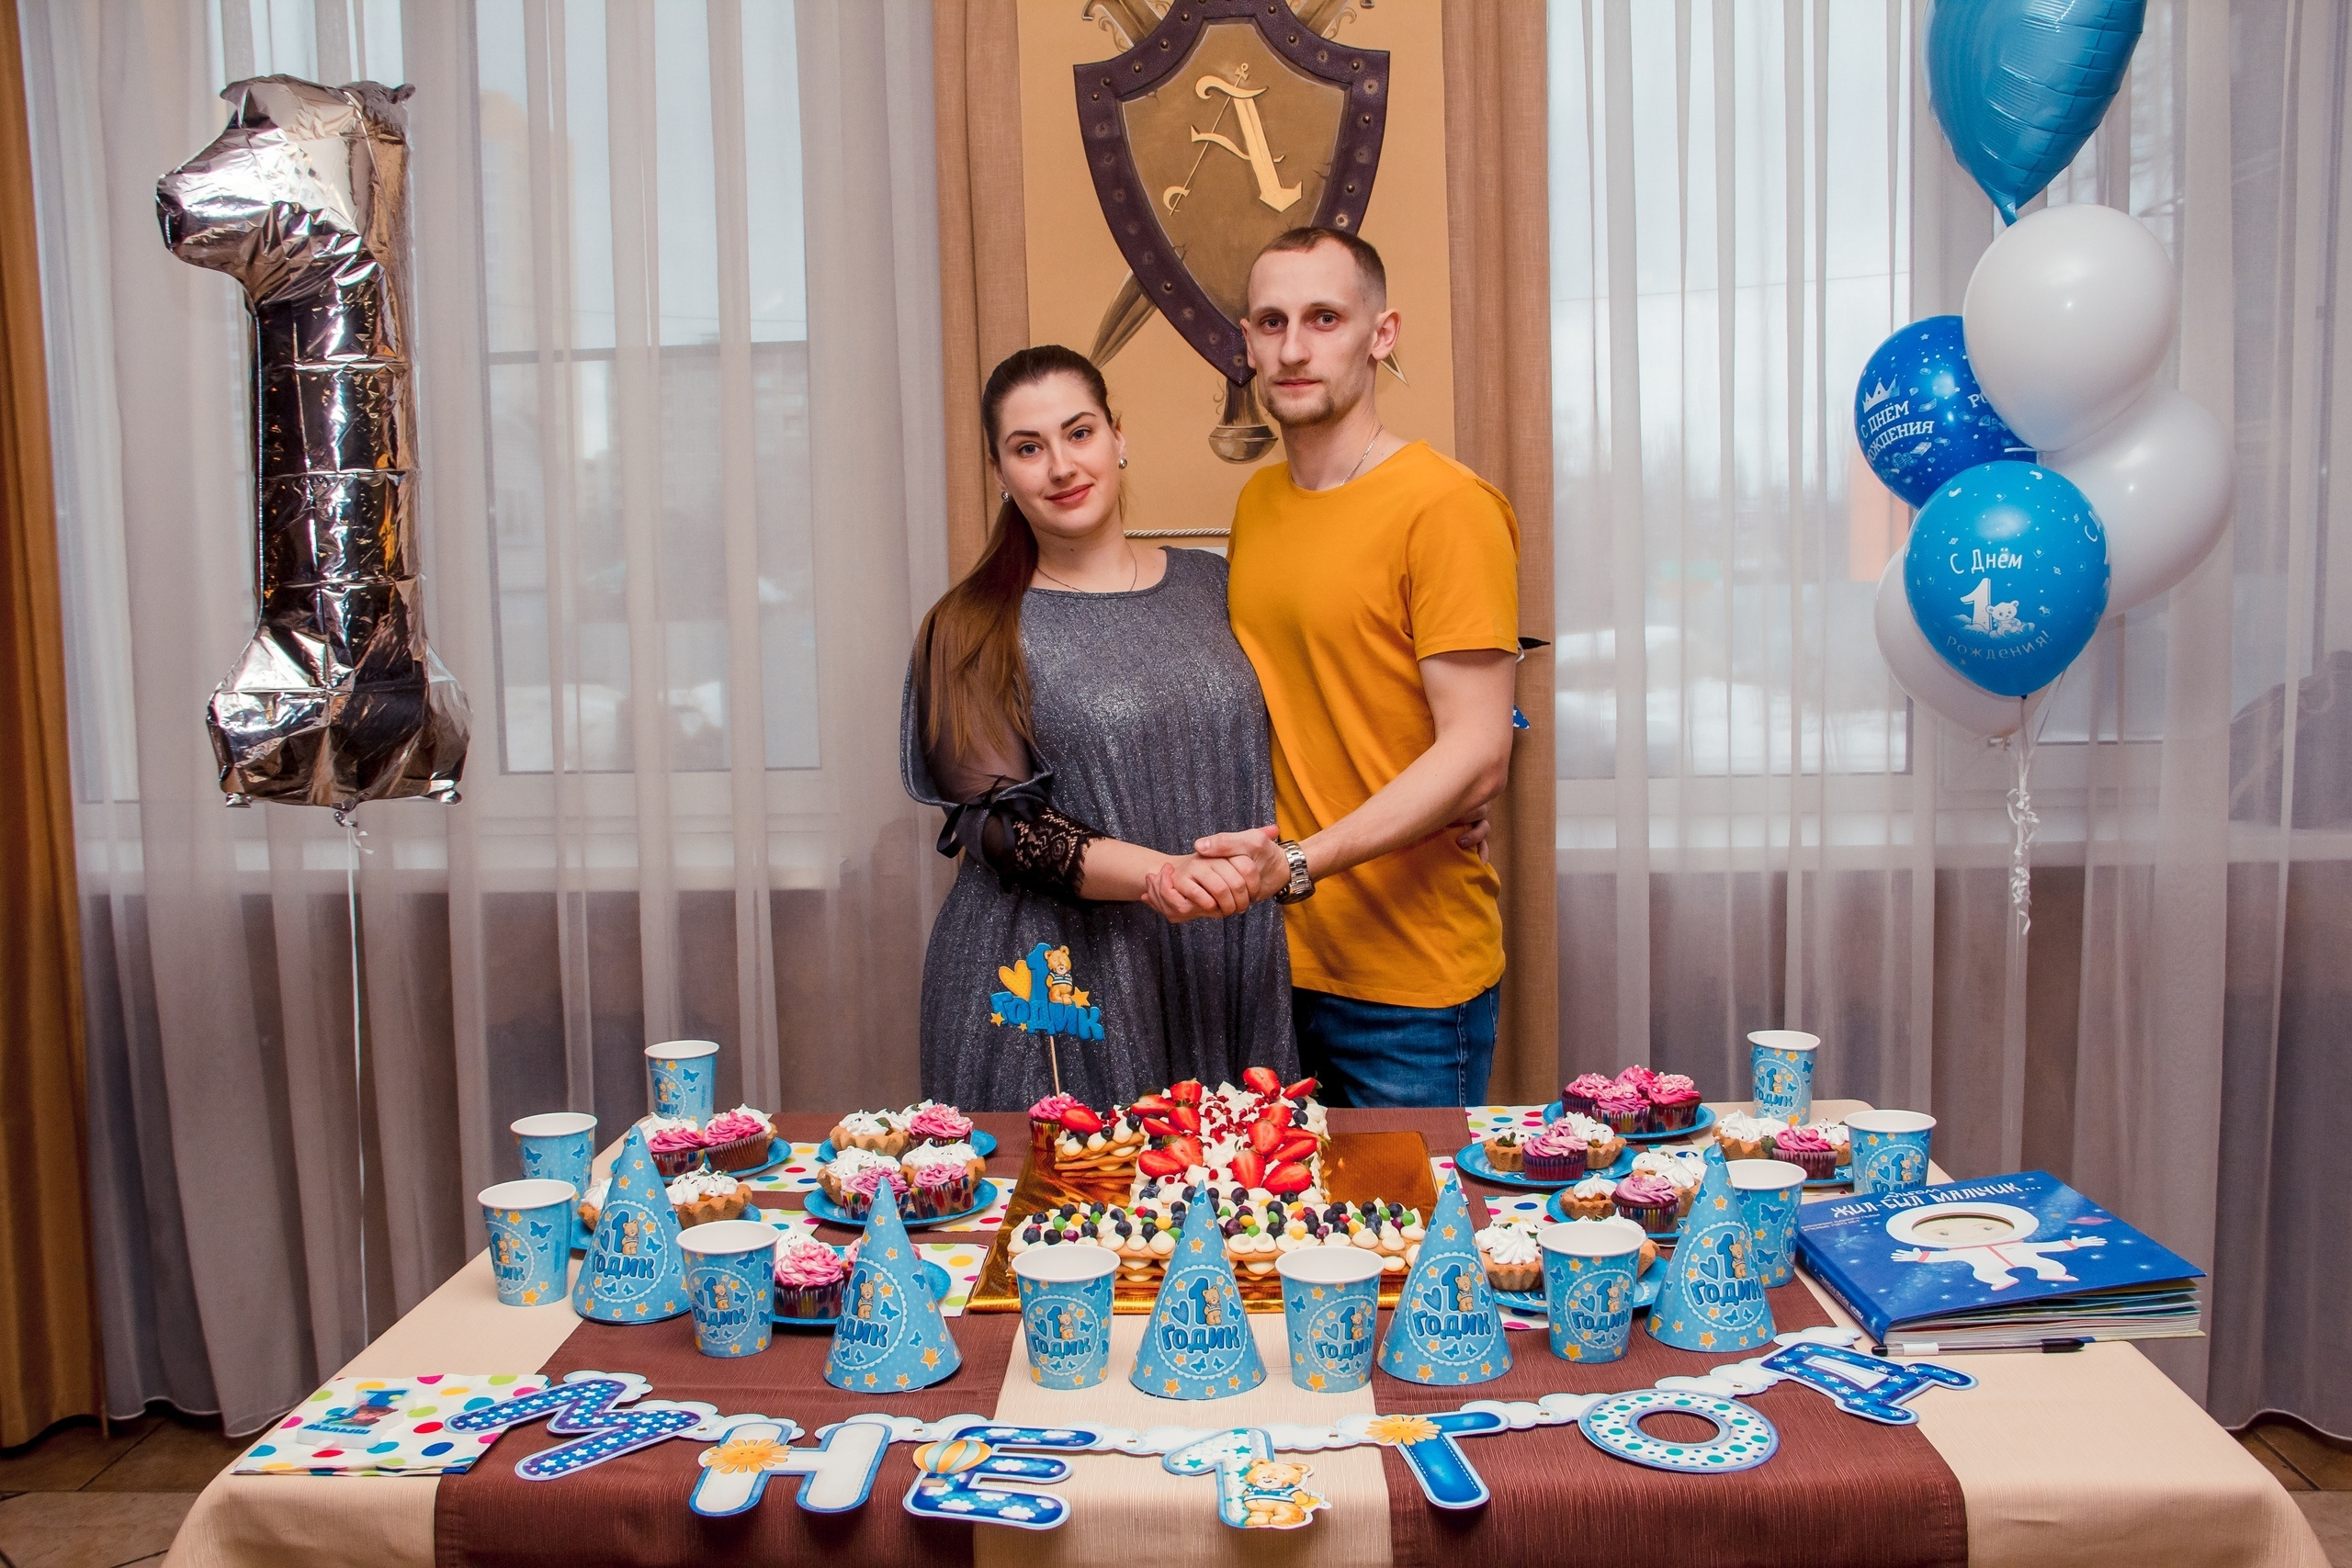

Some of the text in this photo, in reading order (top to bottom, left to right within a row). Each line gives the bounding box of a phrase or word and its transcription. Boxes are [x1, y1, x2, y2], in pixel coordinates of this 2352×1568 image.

[1868, 400, 1910, 435] ДНЁМ
[1960, 577, 1992, 631] 1
[1830, 1194, 1925, 1219] ЖИЛ-БЫЛ
[837, 1314, 888, 1348] ОДИК
